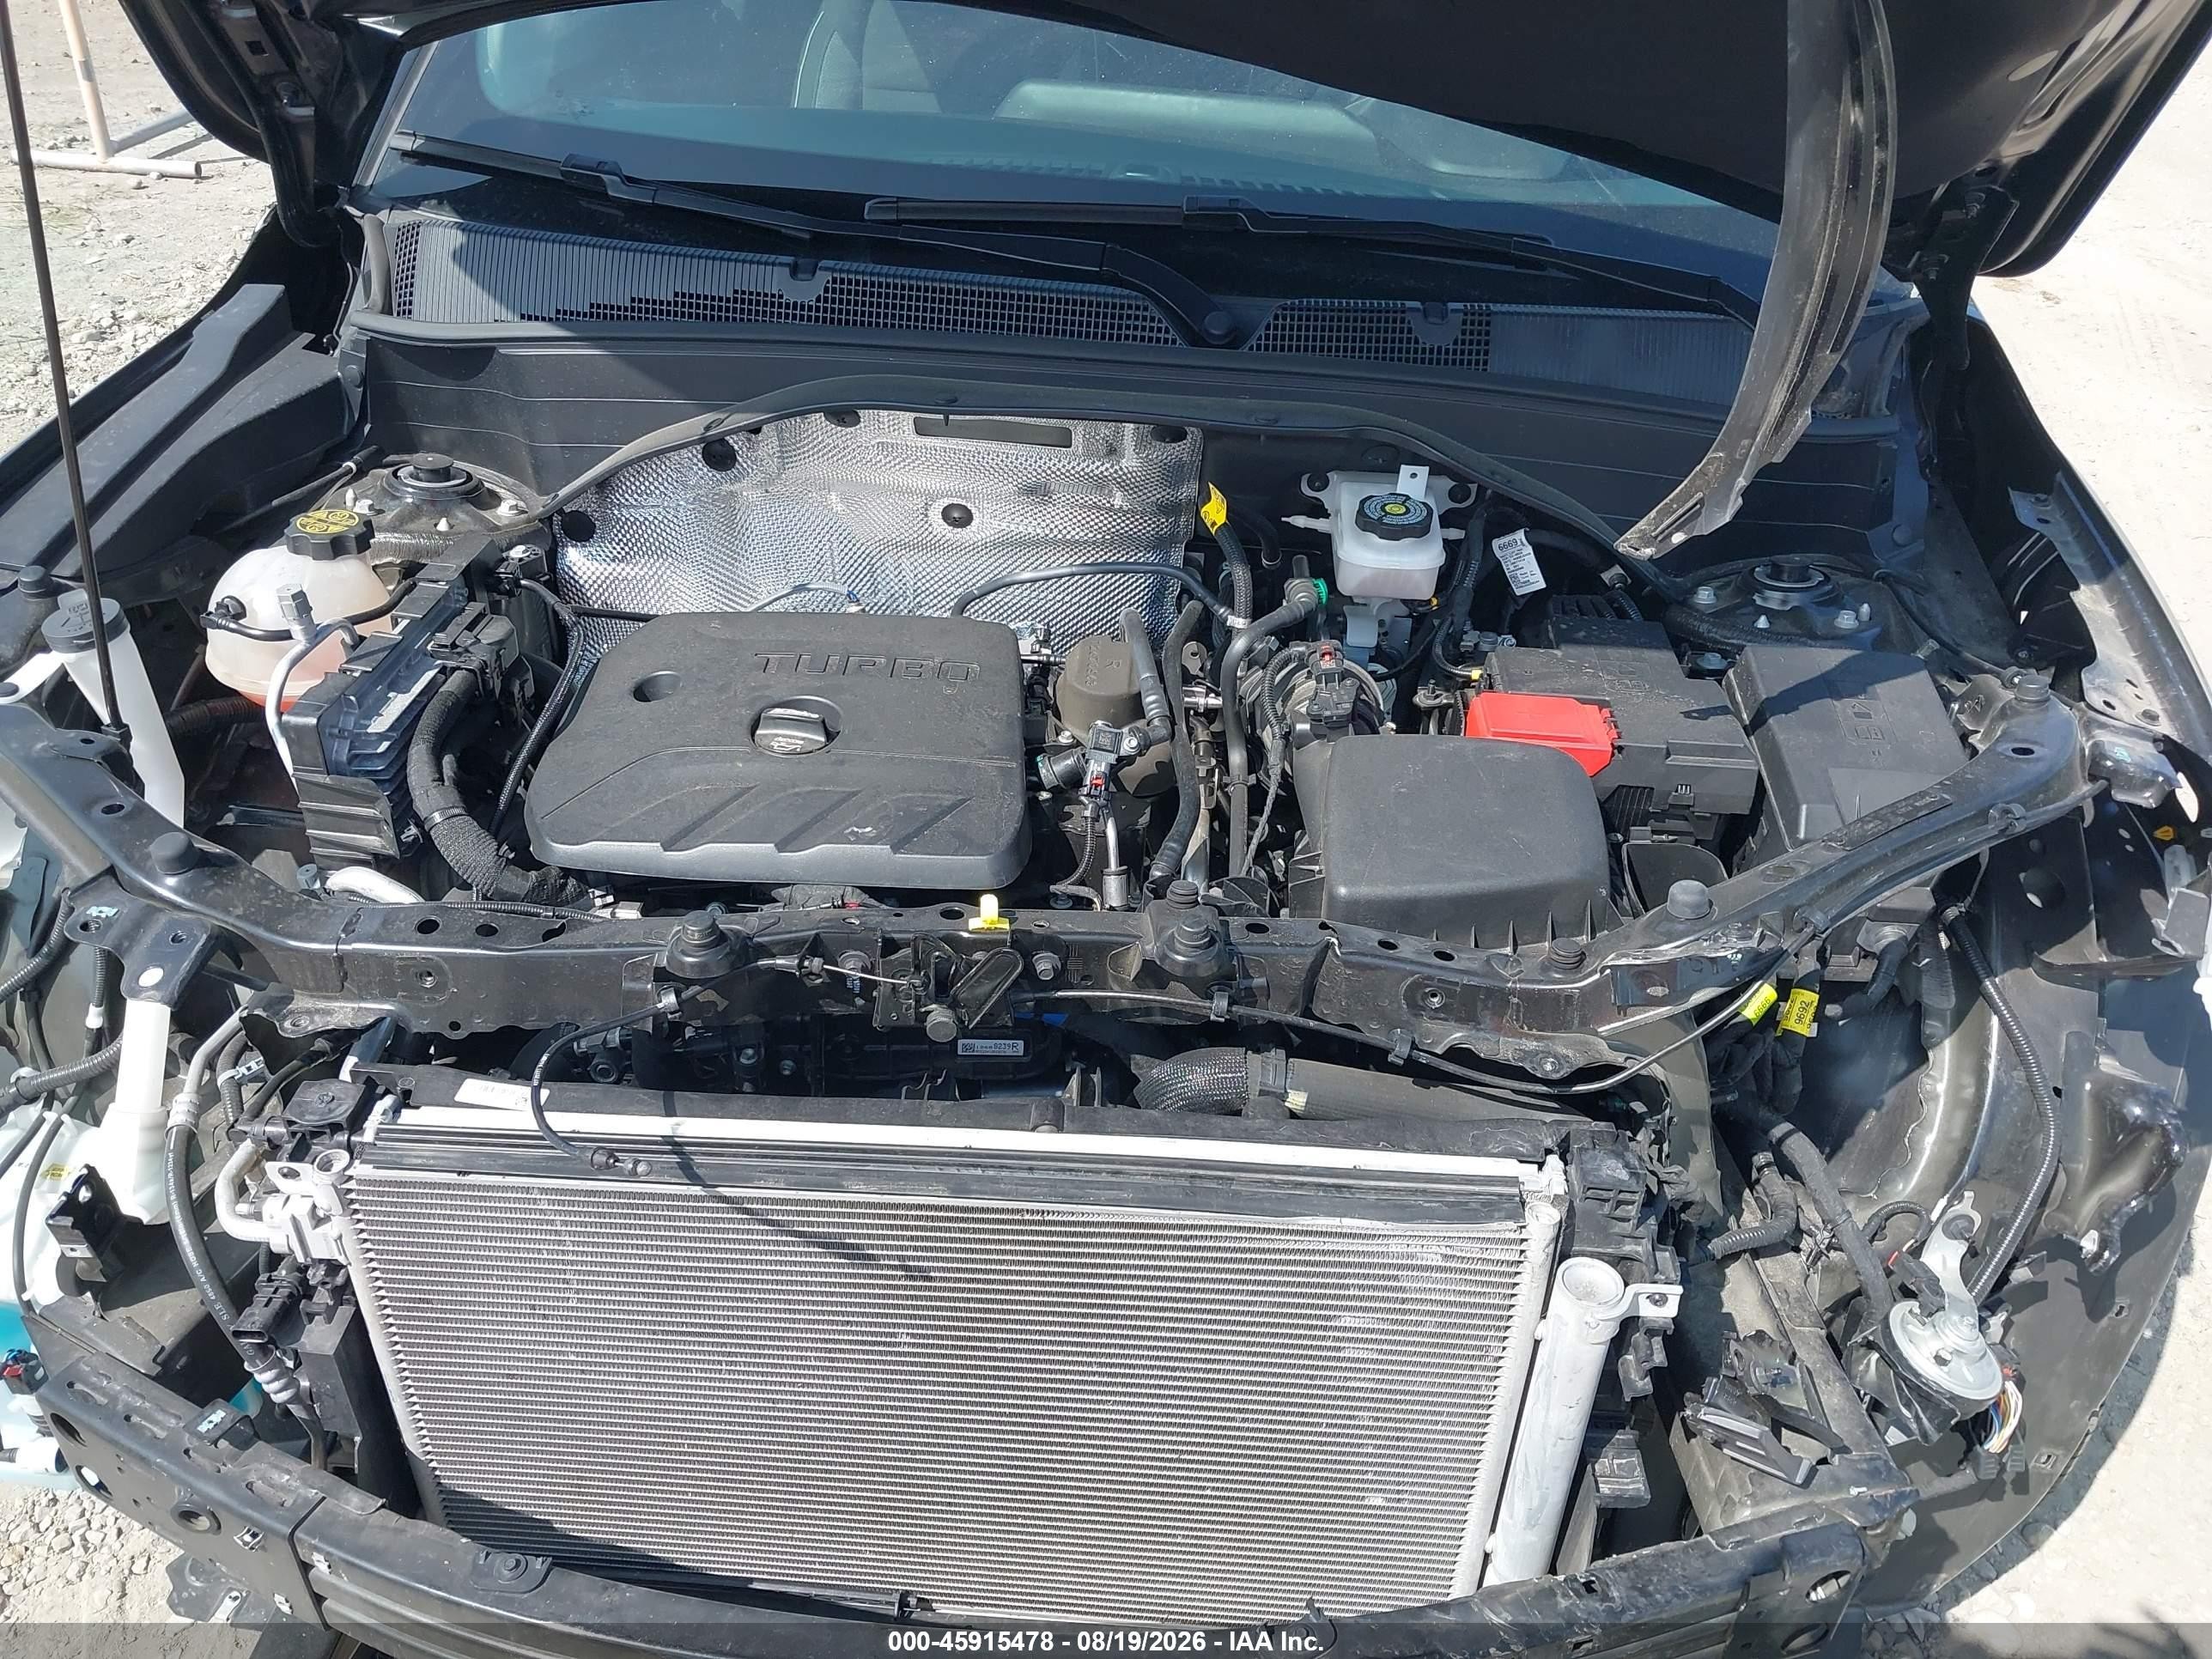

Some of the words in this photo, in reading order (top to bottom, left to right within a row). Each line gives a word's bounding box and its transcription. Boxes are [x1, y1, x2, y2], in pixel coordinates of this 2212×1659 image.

[1498, 538, 1518, 551] 6669
[755, 653, 980, 682] TURBO
[1795, 1000, 1810, 1025] 9692
[184, 1247, 198, 1267] HOSE
[197, 1269, 207, 1282] A/C
